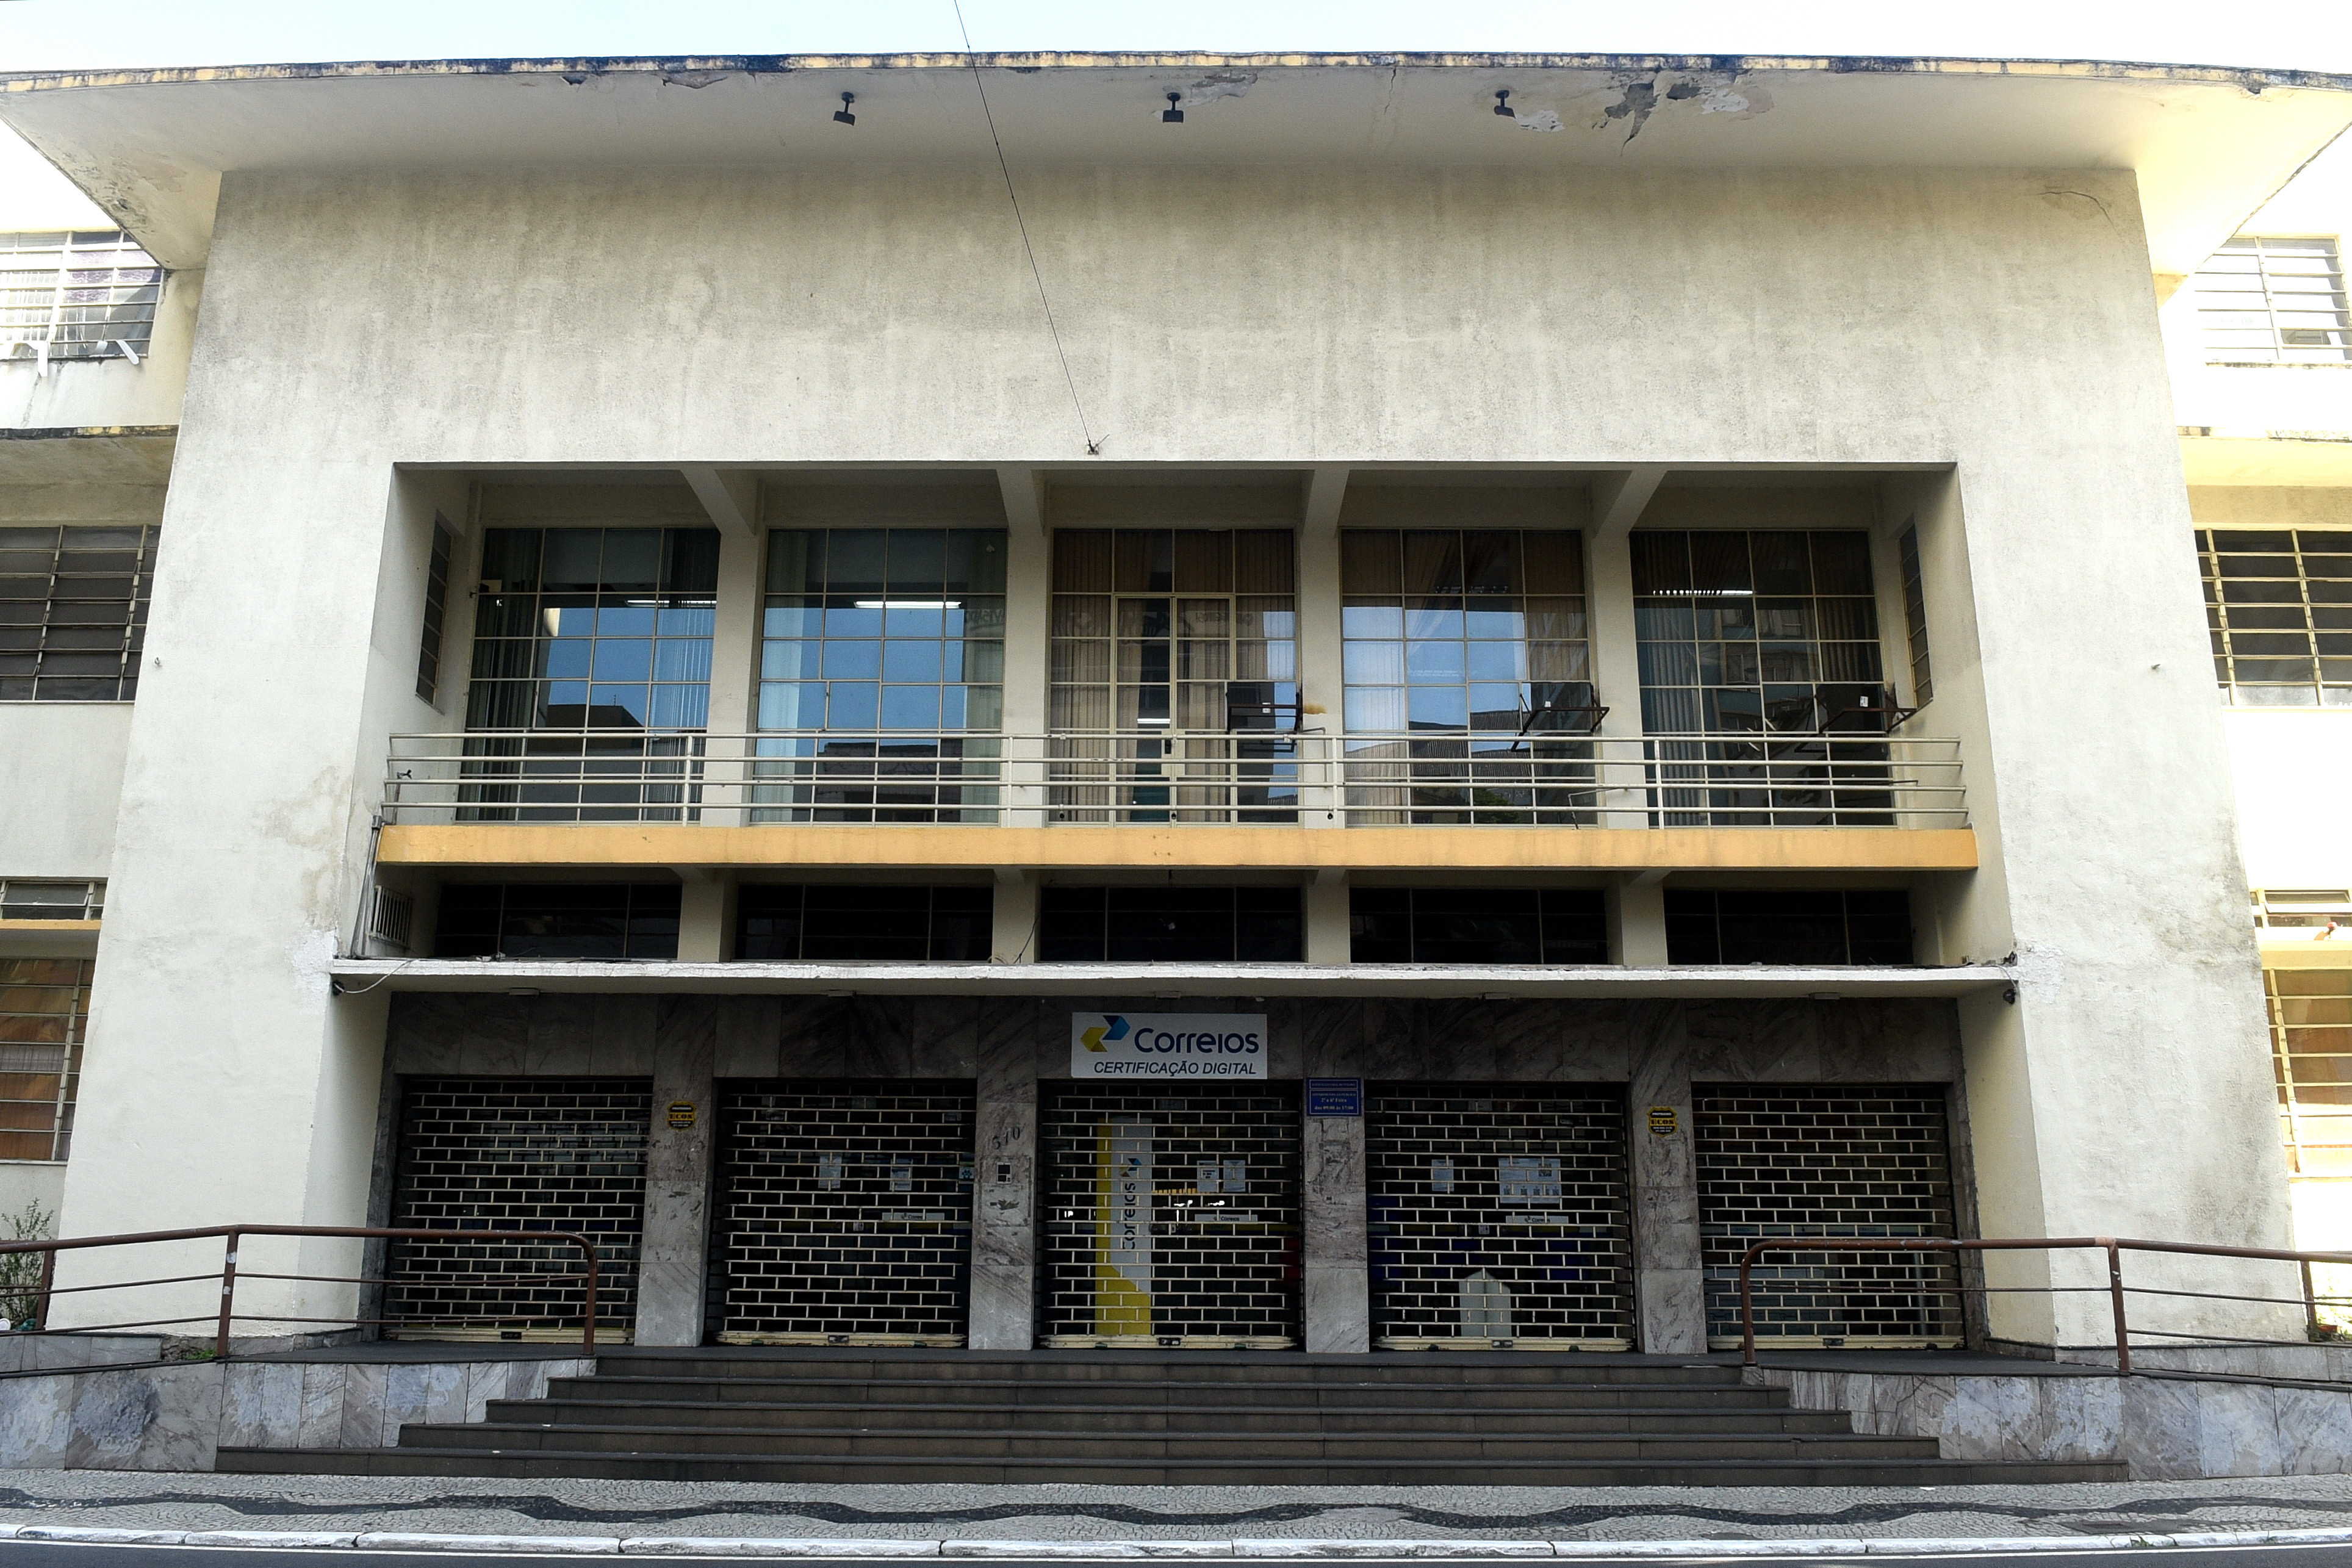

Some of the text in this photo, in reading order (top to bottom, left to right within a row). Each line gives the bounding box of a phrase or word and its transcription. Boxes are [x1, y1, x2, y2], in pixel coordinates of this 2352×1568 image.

[1134, 1027, 1259, 1054] Correios
[1093, 1060, 1257, 1077] CERTIFICAÇÃO DIGITAL
